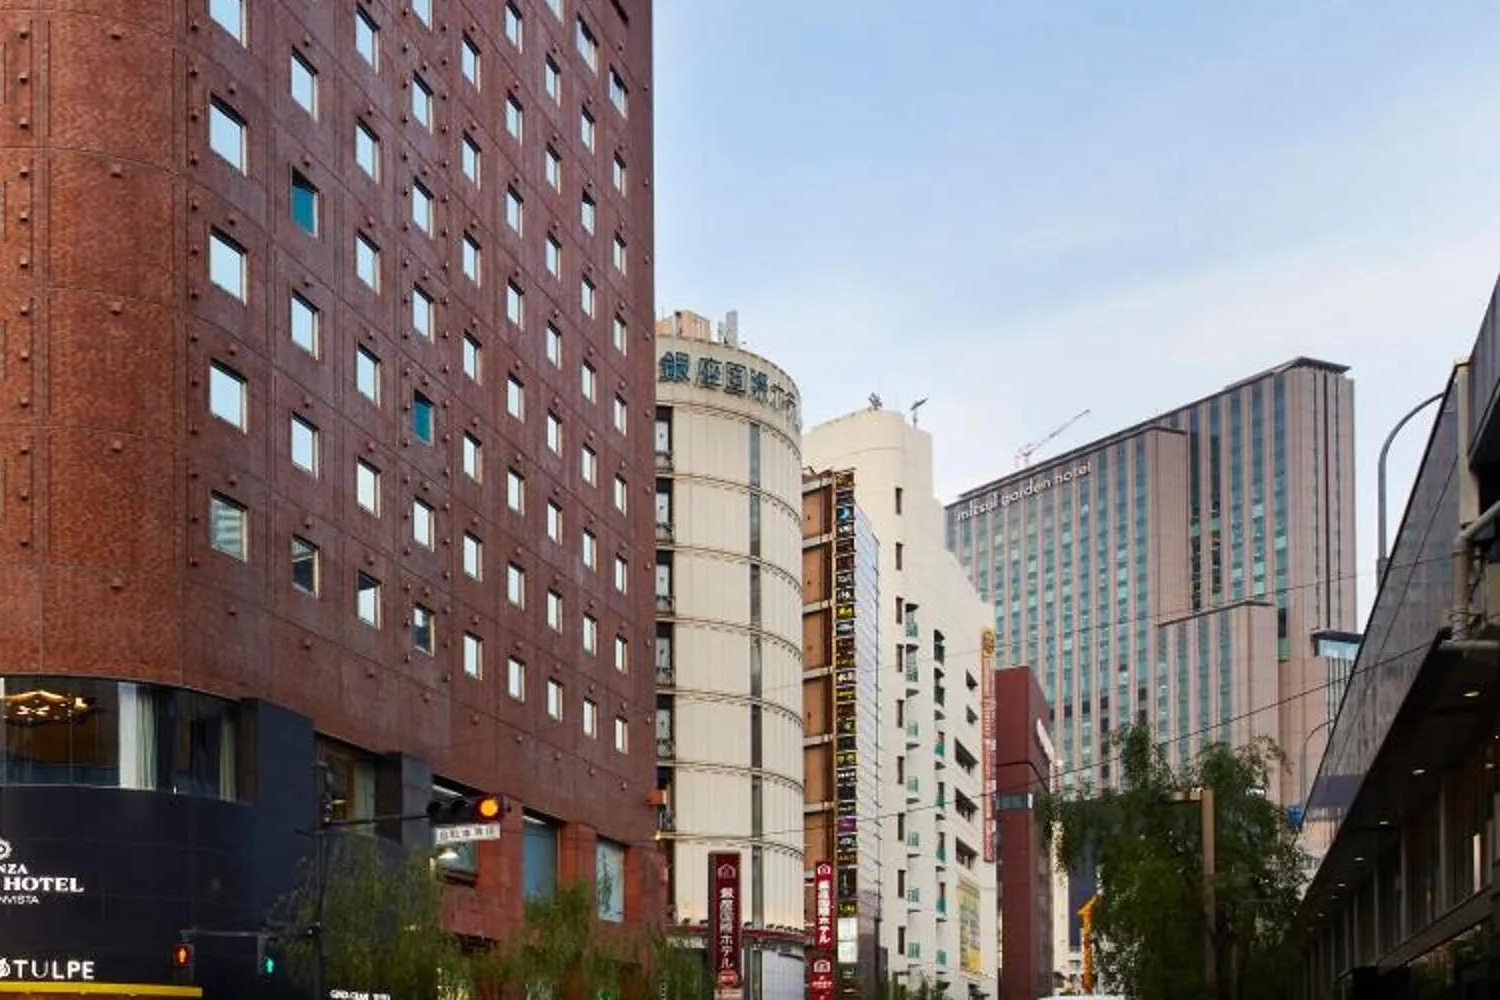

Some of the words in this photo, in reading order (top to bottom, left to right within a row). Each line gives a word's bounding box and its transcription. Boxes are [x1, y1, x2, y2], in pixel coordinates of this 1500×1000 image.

[658, 351, 801, 431] 銀座国際ホテ
[3, 877, 85, 893] HOTEL
[12, 959, 95, 980] TULPE
